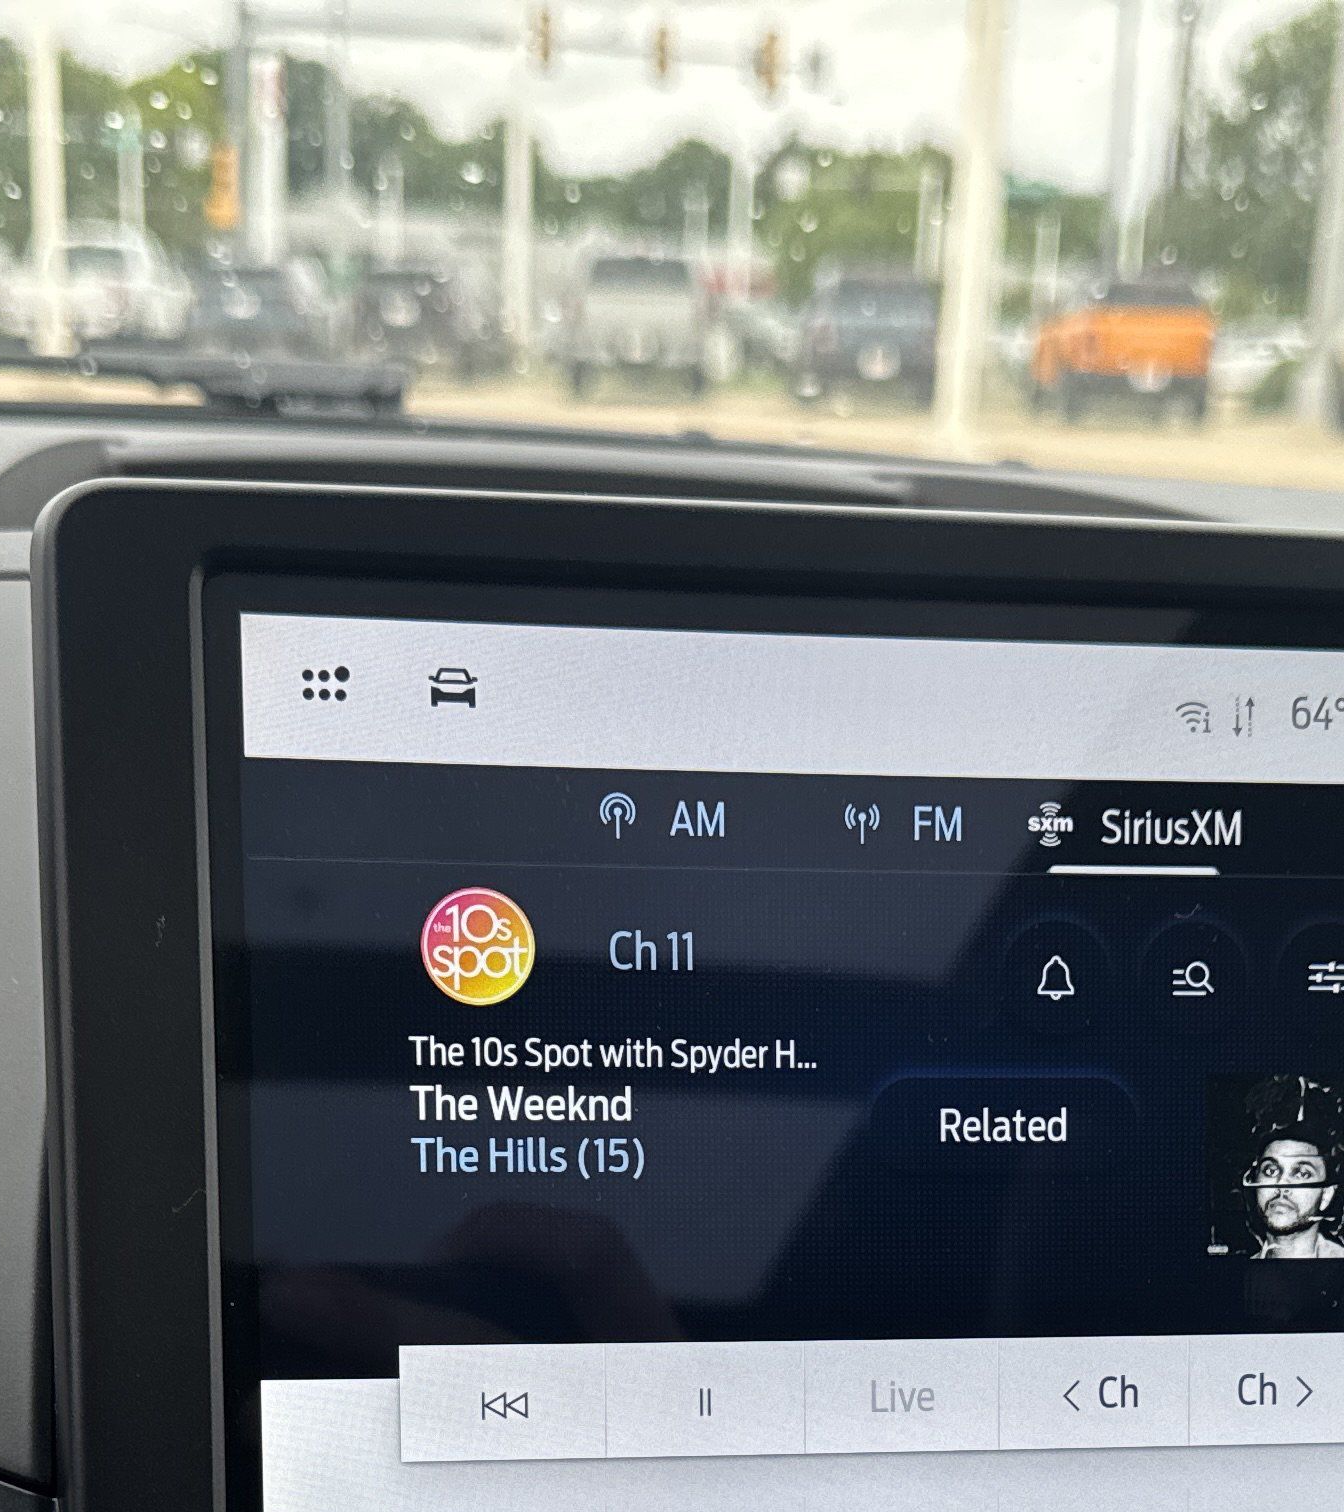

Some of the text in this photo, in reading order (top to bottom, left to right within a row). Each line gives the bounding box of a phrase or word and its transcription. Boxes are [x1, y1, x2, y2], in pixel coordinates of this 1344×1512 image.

[670, 801, 726, 838] AM
[913, 806, 963, 841] FM
[1027, 815, 1074, 834] sxm
[1101, 808, 1243, 847] SiriusXM
[432, 903, 512, 944] the 10s
[432, 936, 528, 991] spot
[609, 929, 694, 971] Ch 11
[408, 1035, 818, 1074] The 10s Spot with Spyder H...
[409, 1084, 633, 1122] The Weeknd
[939, 1107, 1068, 1143] Related
[410, 1136, 646, 1180] The Hills (15)
[870, 1379, 936, 1413] Live
[1097, 1375, 1139, 1409] Ch
[1236, 1372, 1278, 1407] Ch
